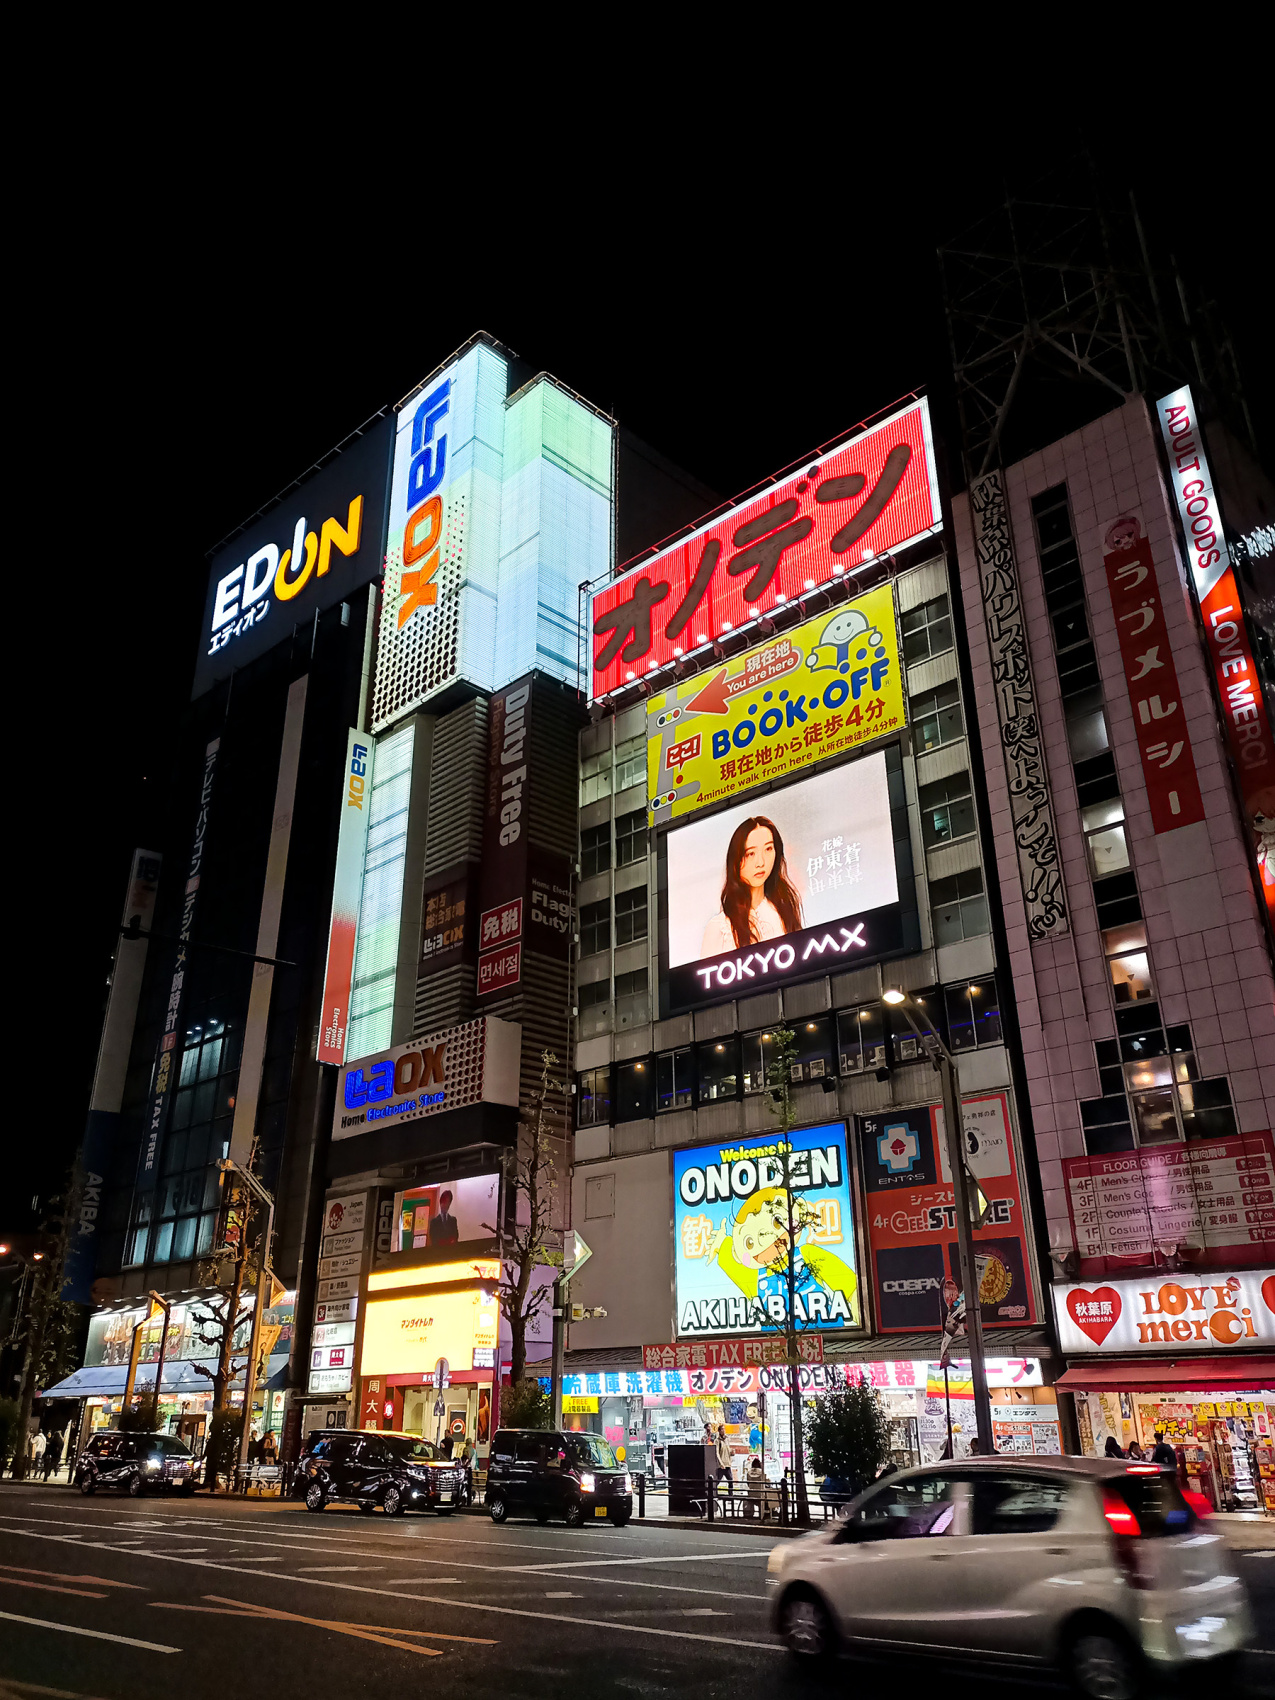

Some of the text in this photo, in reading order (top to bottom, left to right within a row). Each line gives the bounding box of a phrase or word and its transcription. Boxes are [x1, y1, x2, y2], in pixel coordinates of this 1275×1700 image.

[1165, 404, 1220, 570] ADULT GOODS
[211, 494, 364, 632] EDION
[593, 442, 912, 671] オノデン
[207, 599, 270, 656] エディオン
[746, 638, 792, 673] 現在地
[727, 656, 794, 694] You are here
[1114, 560, 1184, 815] ラブメルシー
[1209, 605, 1268, 770] LOVE MERCI
[720, 698, 886, 781] 現在地から徒歩4分
[499, 684, 530, 847] Duty Free
[737, 772, 760, 787] walk
[762, 763, 787, 777] from
[789, 751, 813, 766] here
[483, 906, 518, 942] 免税
[531, 908, 568, 934] Duty
[480, 953, 518, 984] 면세점
[697, 922, 867, 990] TOKYO MX
[323, 1007, 345, 1050] Home Electronics Store
[151, 1095, 163, 1130] TAX
[341, 1090, 444, 1129] Home Electronics Store
[864, 1121, 877, 1133] 5F
[144, 1134, 157, 1171] FREE
[719, 1140, 793, 1163] Welcome to
[1103, 1160, 1138, 1173] FLOOR
[1140, 1154, 1173, 1167] GUIDE
[680, 1146, 842, 1205] ONODEN
[1077, 1179, 1092, 1191] 4F
[1101, 1176, 1129, 1187] Men's
[78, 1171, 104, 1235] AKIBA
[1079, 1194, 1094, 1207] 3F
[1104, 1192, 1131, 1203] Men's
[1176, 1180, 1213, 1194] 男性用品
[873, 1214, 889, 1229] 4F
[1082, 1211, 1097, 1223] 2F
[1085, 1227, 1099, 1239] 1F
[1158, 1220, 1201, 1231] Lingerie
[1111, 1242, 1142, 1253] Fetish
[883, 1278, 937, 1292] COSPA
[898, 1289, 927, 1297] cospa.com
[1139, 1282, 1238, 1316] LOVE
[681, 1289, 852, 1331] AKIHABARA
[1075, 1301, 1113, 1317] 秋葉原
[1078, 1316, 1113, 1324] AKIHABARA
[645, 1344, 707, 1369] 総合家電
[708, 1343, 741, 1365] TAX
[743, 1340, 782, 1363] FREE
[625, 1369, 683, 1393] 洗濯機
[691, 1366, 752, 1391] オノデン
